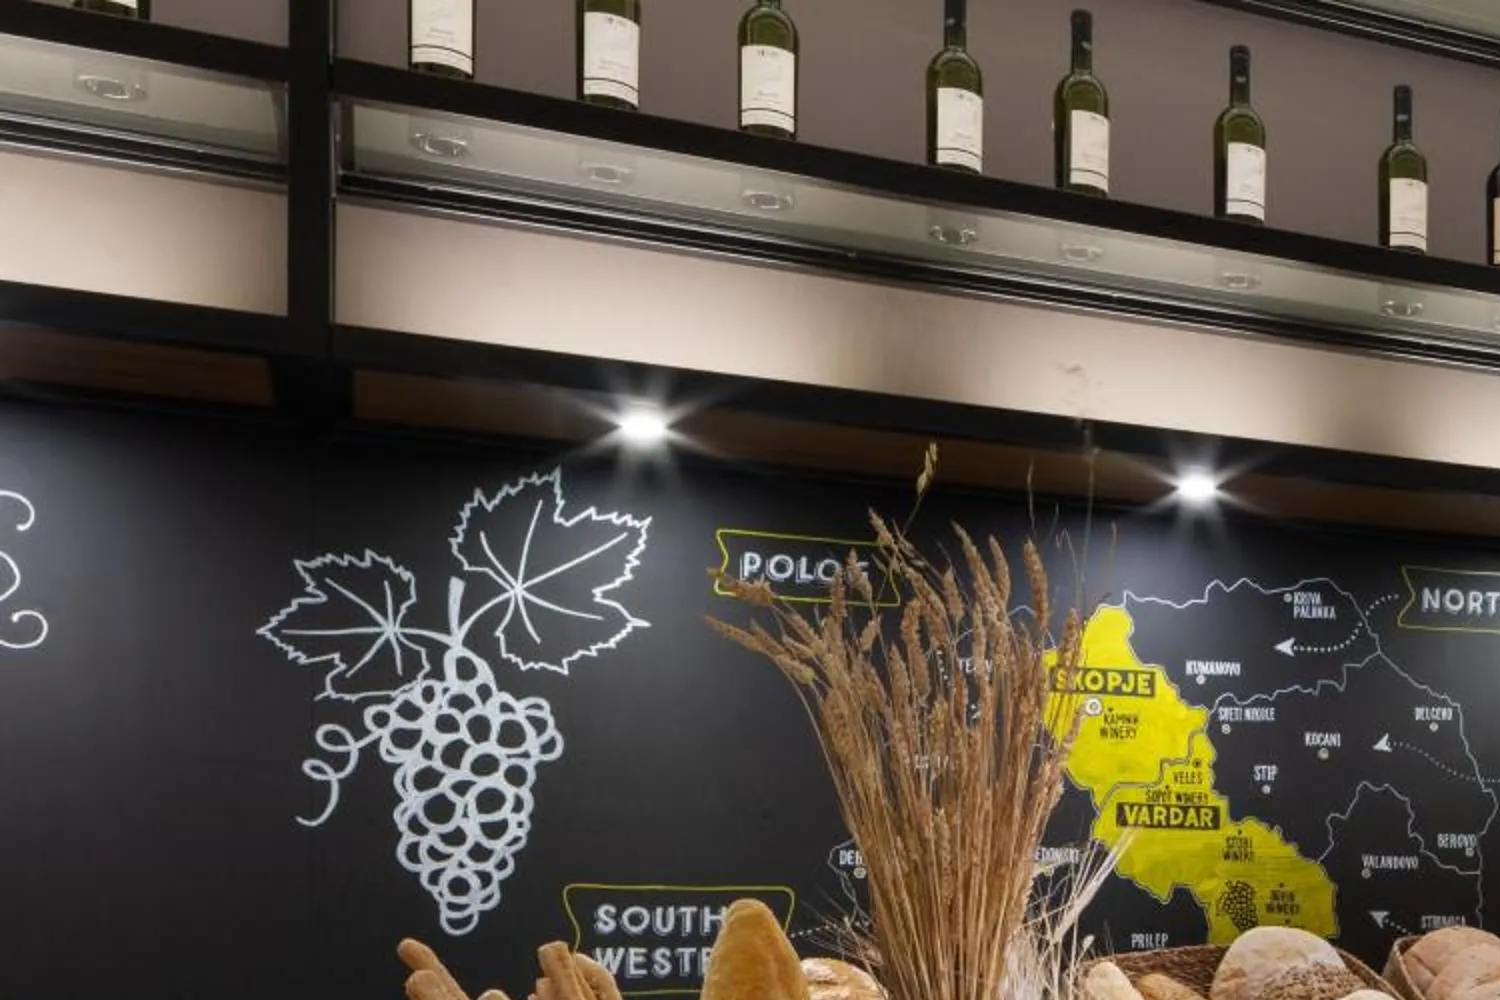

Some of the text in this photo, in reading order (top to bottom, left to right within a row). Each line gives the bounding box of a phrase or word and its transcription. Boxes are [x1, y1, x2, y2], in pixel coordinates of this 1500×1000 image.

[1185, 660, 1241, 677] KUMANOVO
[1055, 671, 1151, 694] SKOPJE
[1304, 732, 1341, 747] KOCANI
[1254, 765, 1278, 781] STIP
[1123, 805, 1215, 828] VARDAR
[1437, 833, 1478, 849] BEROVO
[1361, 853, 1420, 870] VALANDOVO
[594, 903, 728, 937] SOUTH
[1132, 933, 1168, 949] PRILEP
[592, 946, 712, 979] WEST
